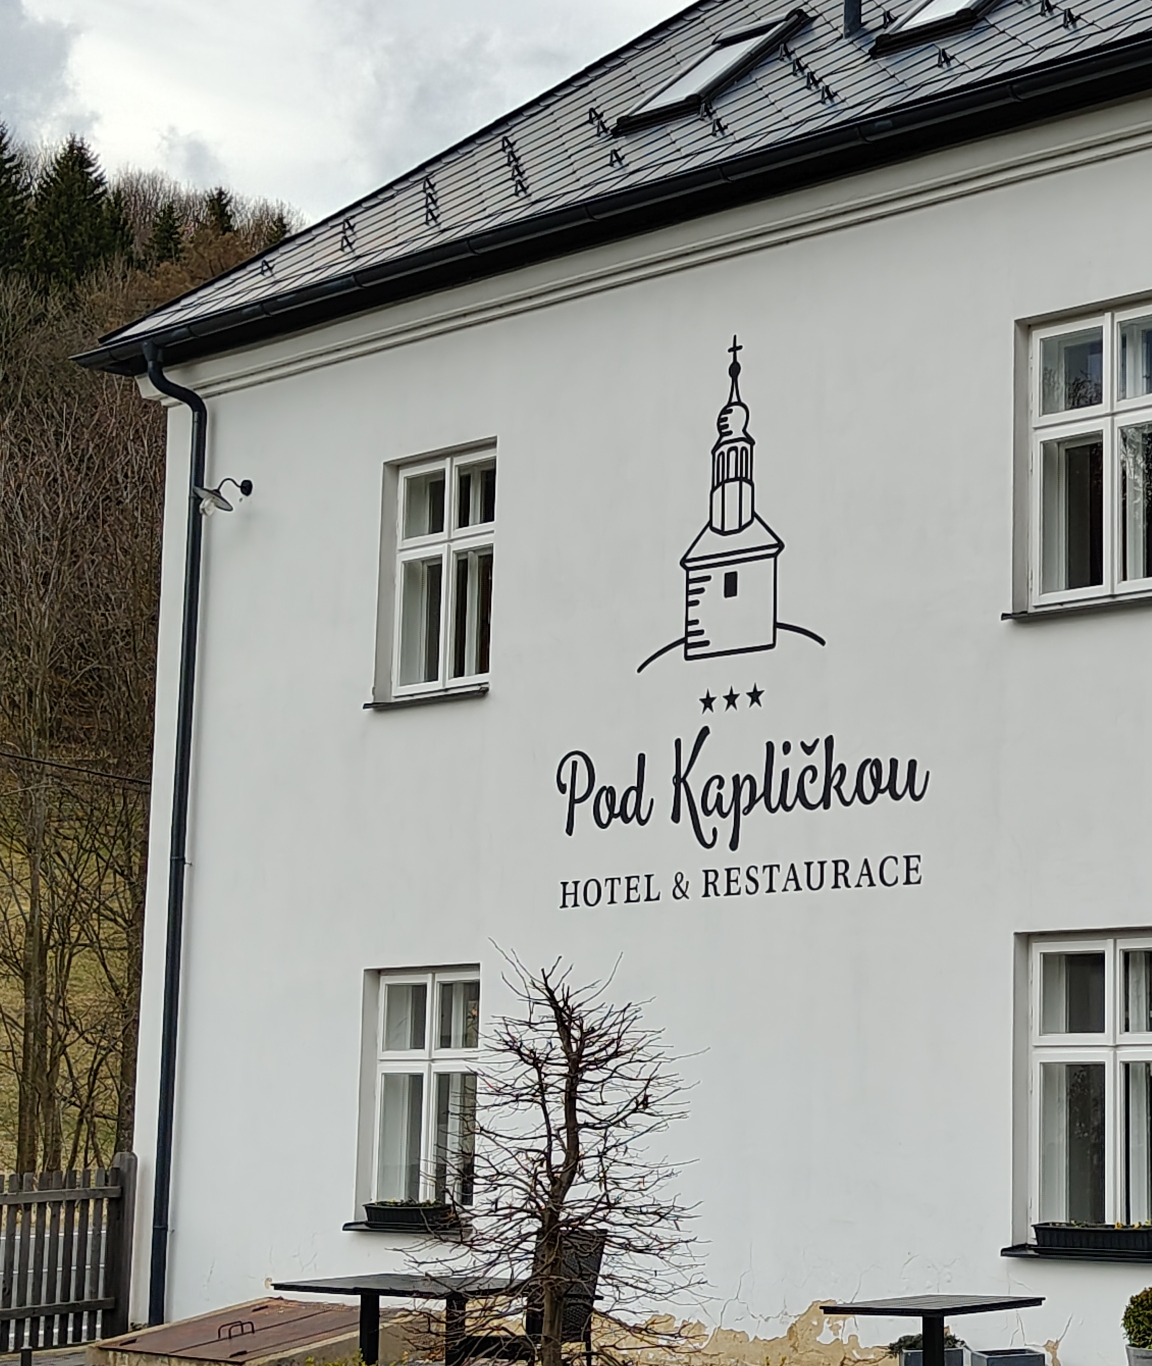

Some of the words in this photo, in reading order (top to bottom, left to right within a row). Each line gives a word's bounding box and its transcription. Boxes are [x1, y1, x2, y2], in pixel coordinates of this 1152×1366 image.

[556, 750, 654, 837] Pod
[671, 725, 930, 852] Kapličkou
[558, 873, 661, 909] HOTEL
[672, 871, 690, 901] &
[701, 854, 923, 899] RESTAURACE
